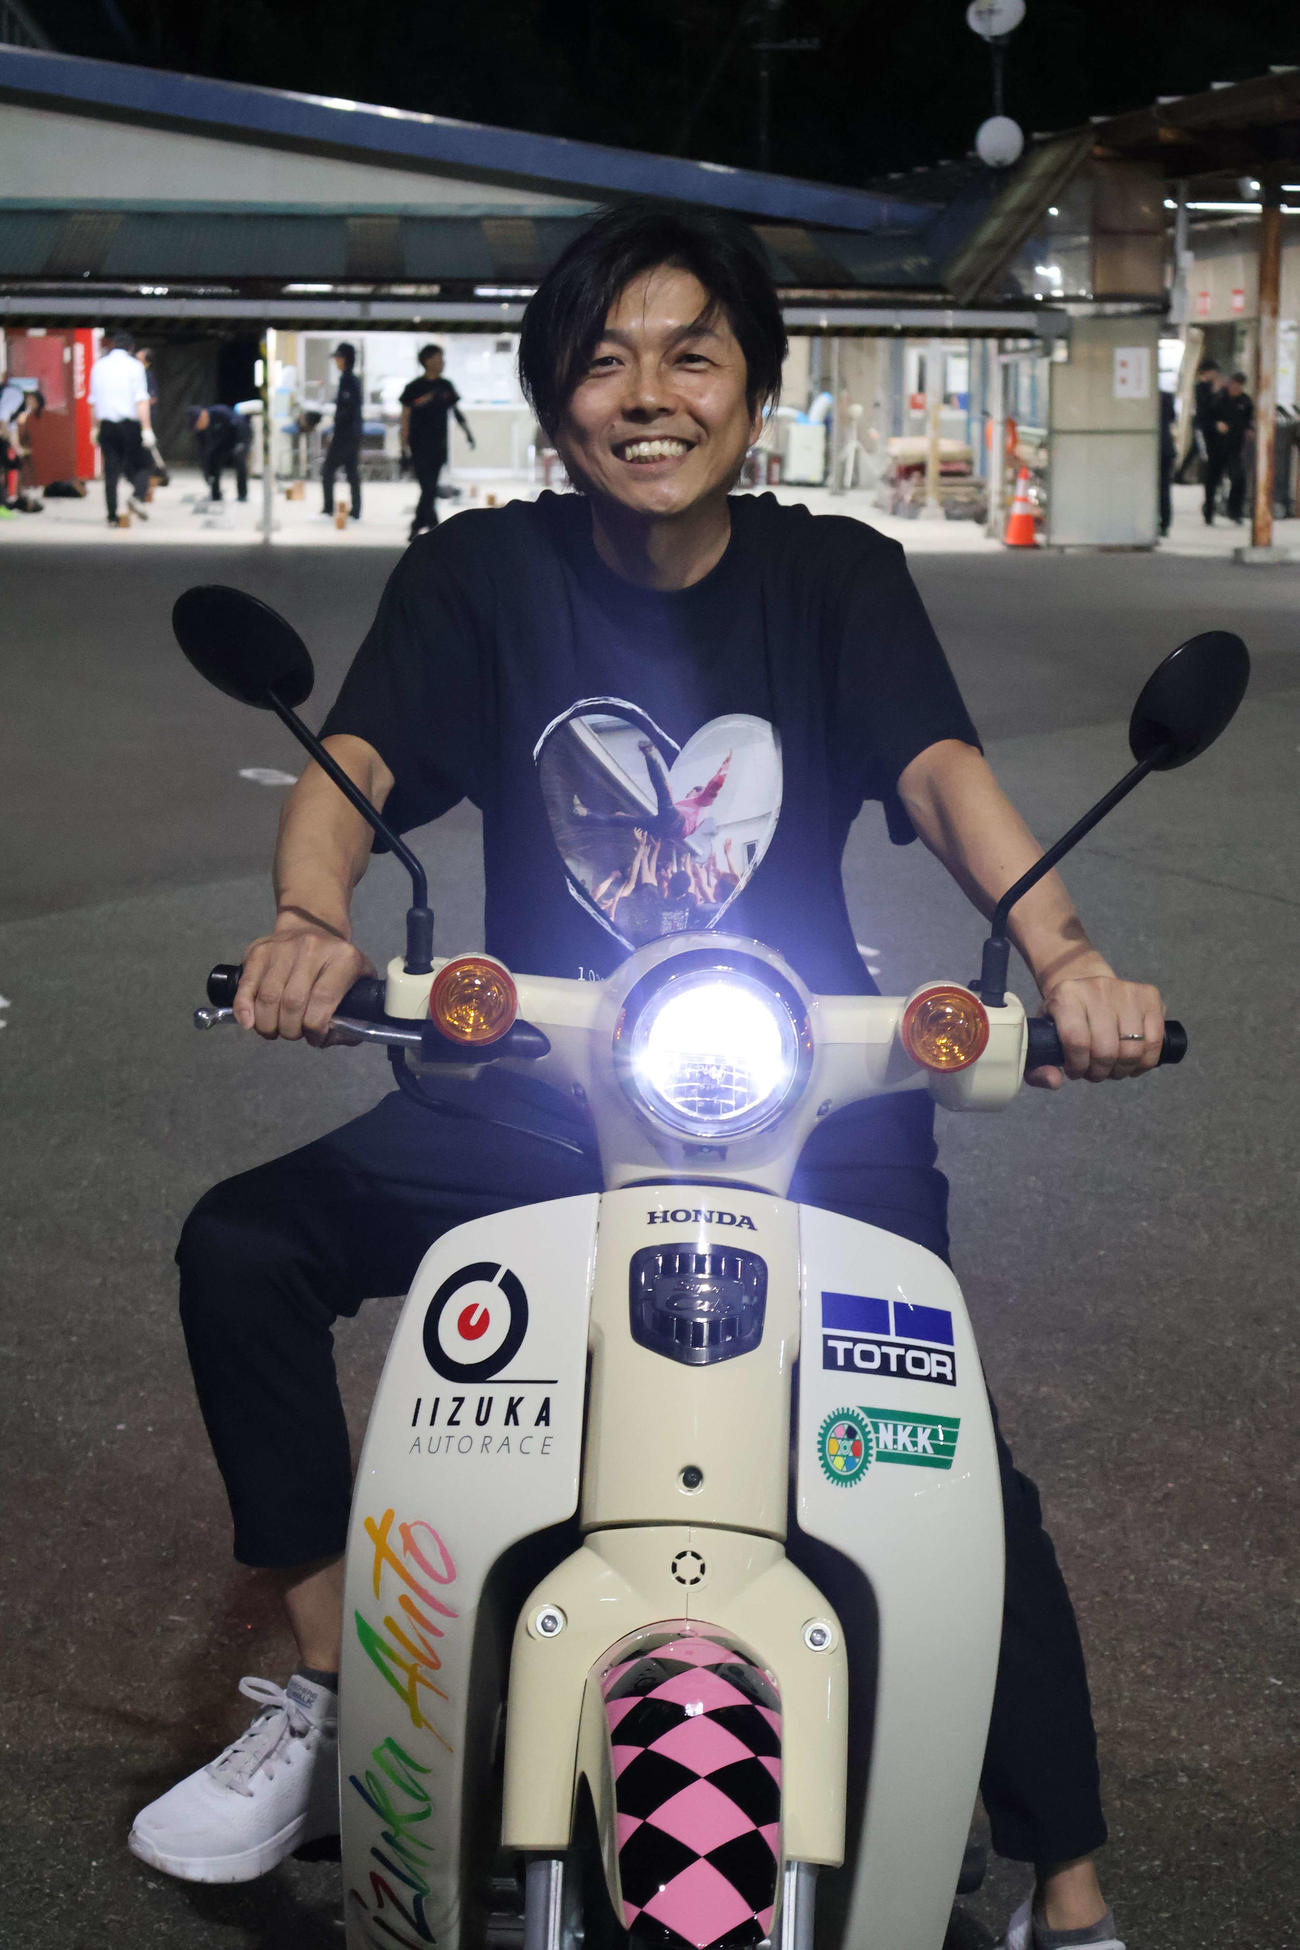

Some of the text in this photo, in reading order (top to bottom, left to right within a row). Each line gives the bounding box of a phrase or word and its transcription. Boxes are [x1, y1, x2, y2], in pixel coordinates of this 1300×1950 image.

[647, 1209, 758, 1231] HONDA
[827, 1339, 953, 1380] TOTOR
[412, 1396, 551, 1426] IIZUKA
[409, 1435, 554, 1455] AUTORACE
[354, 1507, 459, 1753] Auto
